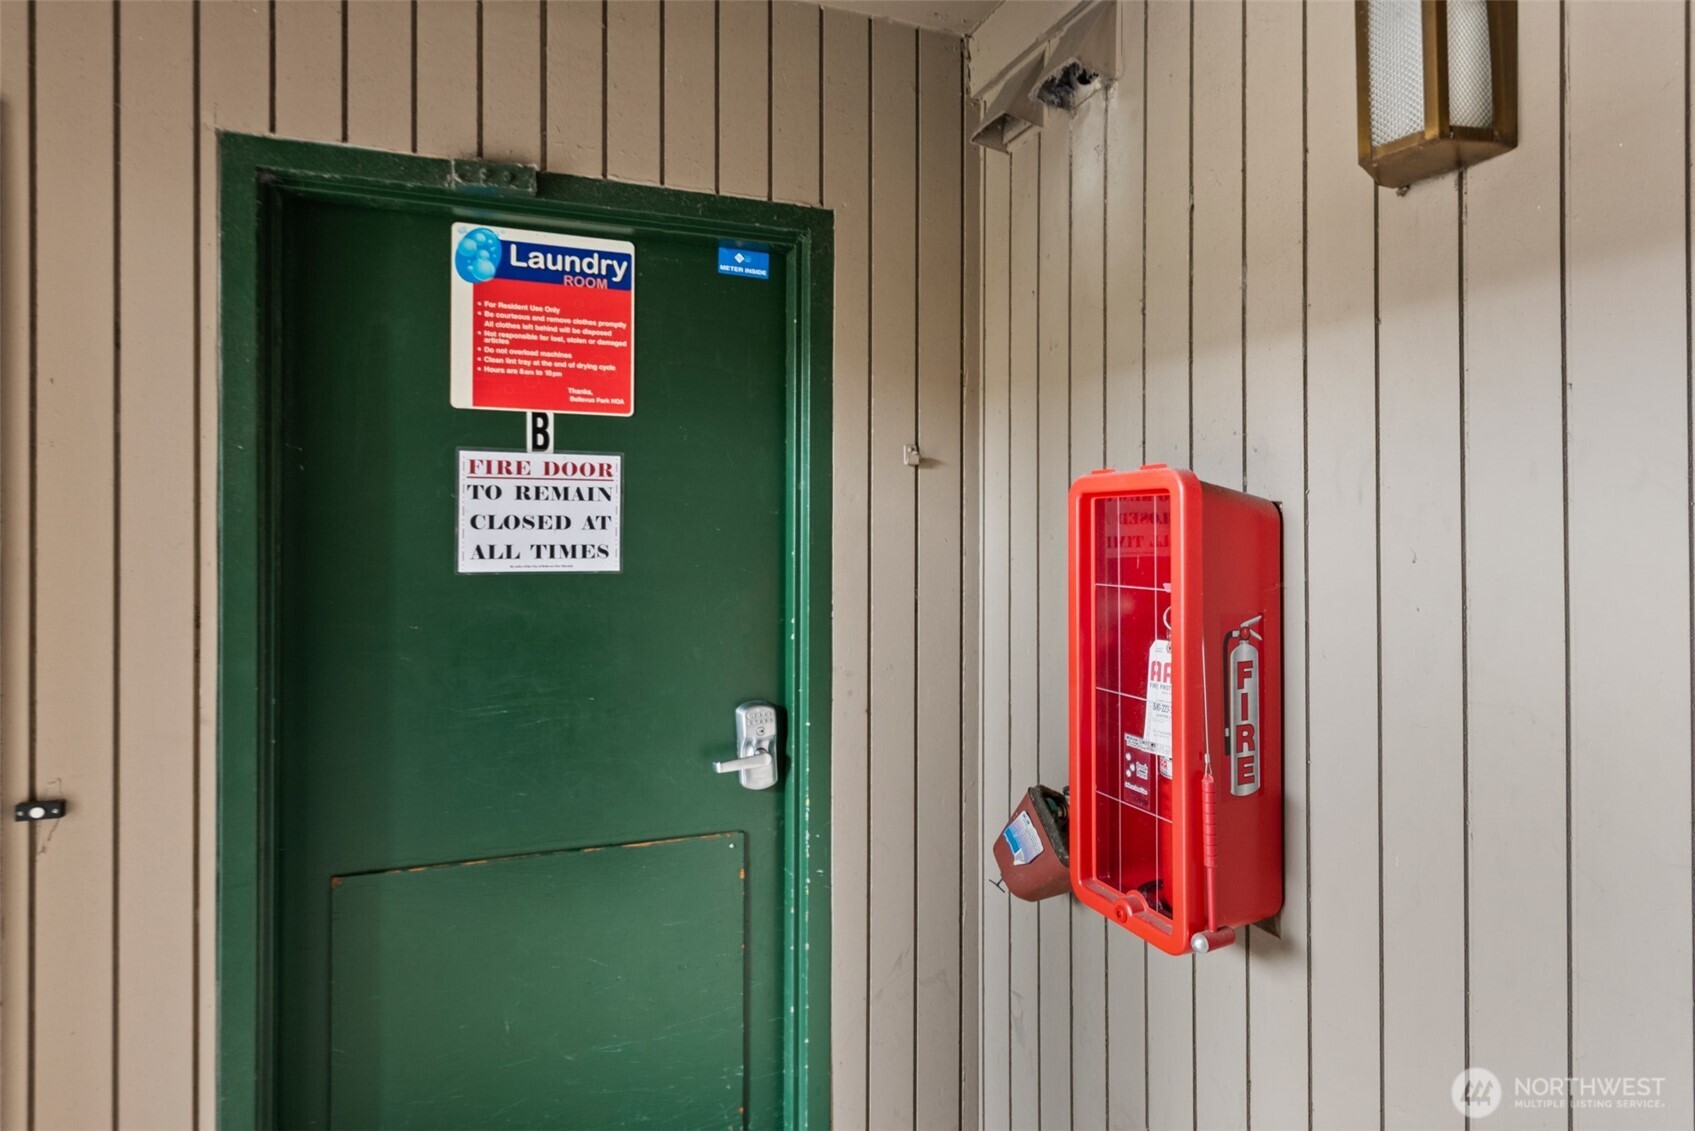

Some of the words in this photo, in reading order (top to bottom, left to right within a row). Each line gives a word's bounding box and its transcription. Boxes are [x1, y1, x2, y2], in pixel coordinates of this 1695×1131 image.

[509, 243, 628, 283] Laundry
[720, 264, 743, 273] METER
[744, 267, 767, 276] INSIDE
[563, 274, 608, 289] ROOM
[498, 302, 528, 310] Resident
[544, 306, 560, 315] Only
[573, 318, 597, 326] clothes
[598, 321, 627, 329] promptly
[498, 332, 538, 340] responsible
[597, 339, 627, 347] damaged
[576, 363, 597, 371] drying
[531, 412, 550, 451] B
[468, 458, 531, 476] FIRE
[544, 461, 614, 478] DOOR
[467, 484, 502, 500] TO
[516, 485, 613, 501] REMAIN
[470, 514, 572, 530] CLOSED
[582, 515, 612, 530] AT
[471, 544, 521, 560] ALL
[530, 544, 610, 559] TIMES
[1236, 660, 1255, 786] FIRE
